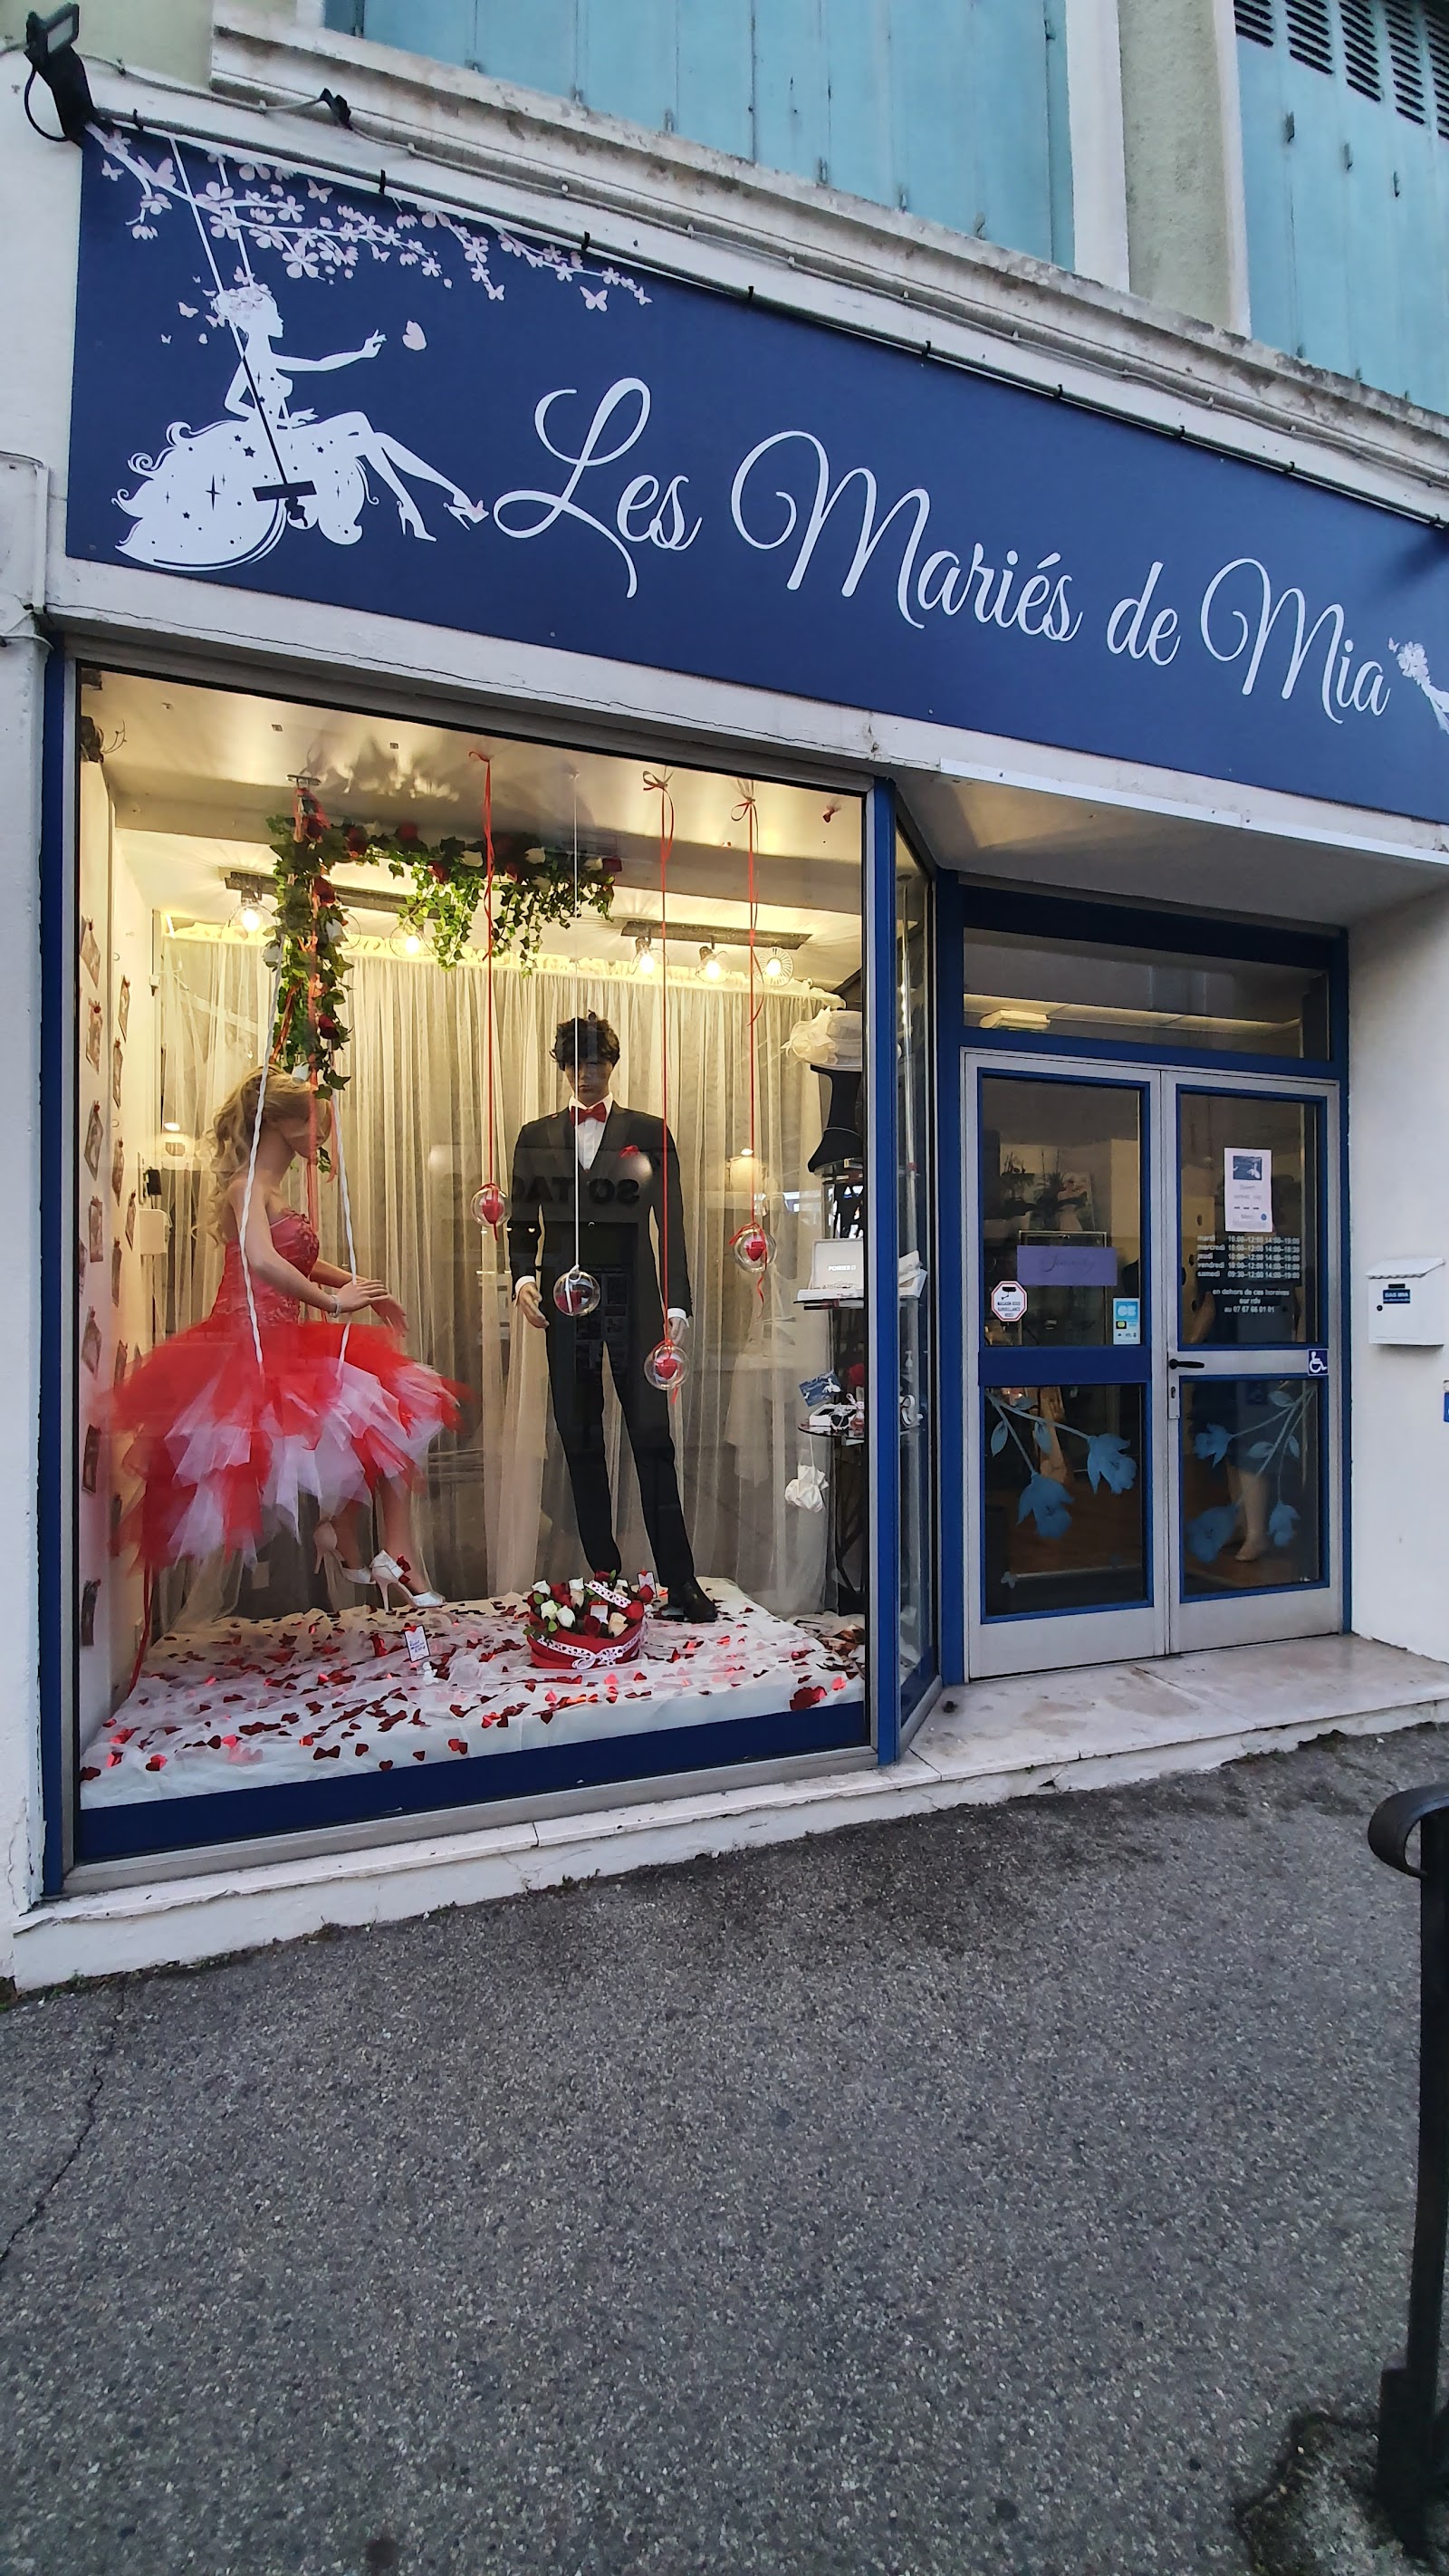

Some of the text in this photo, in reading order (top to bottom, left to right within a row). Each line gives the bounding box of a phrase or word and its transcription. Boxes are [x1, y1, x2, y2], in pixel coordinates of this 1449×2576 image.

[493, 377, 1391, 725] Les Mariés de Mia
